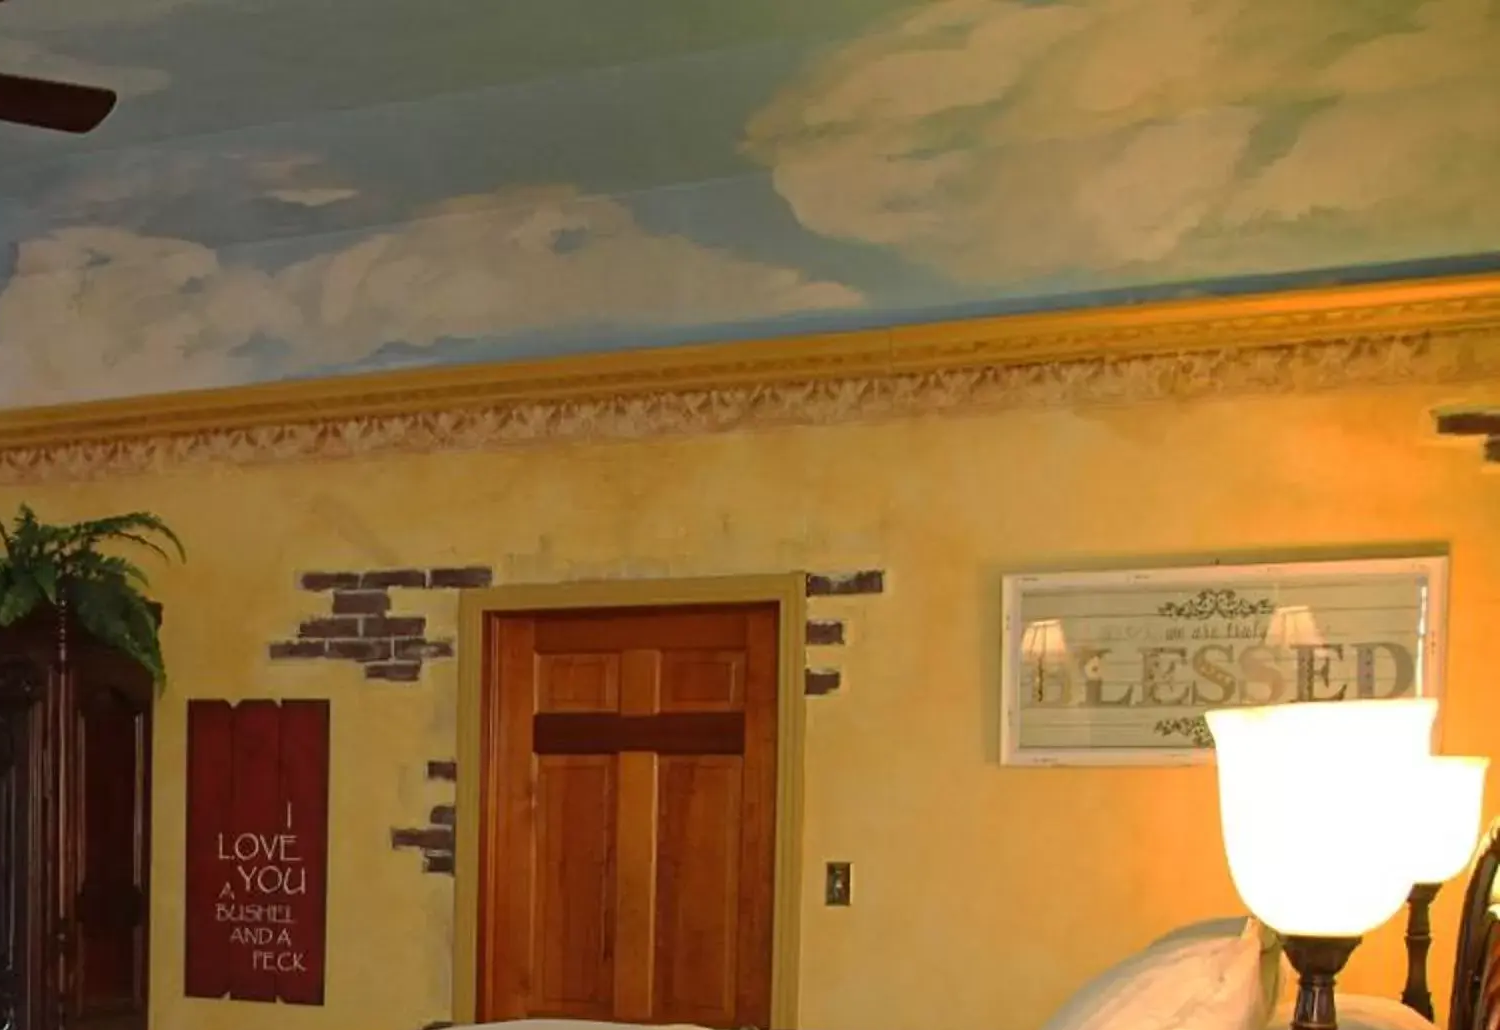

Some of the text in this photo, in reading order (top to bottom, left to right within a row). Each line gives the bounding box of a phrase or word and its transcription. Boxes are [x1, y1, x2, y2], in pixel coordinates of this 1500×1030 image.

[286, 800, 292, 829] I
[218, 832, 303, 861] LOVE
[219, 881, 235, 900] A
[237, 865, 306, 895] YOU
[215, 903, 297, 924] BUSHEL
[230, 927, 291, 947] AND A
[252, 950, 307, 972] PECK
